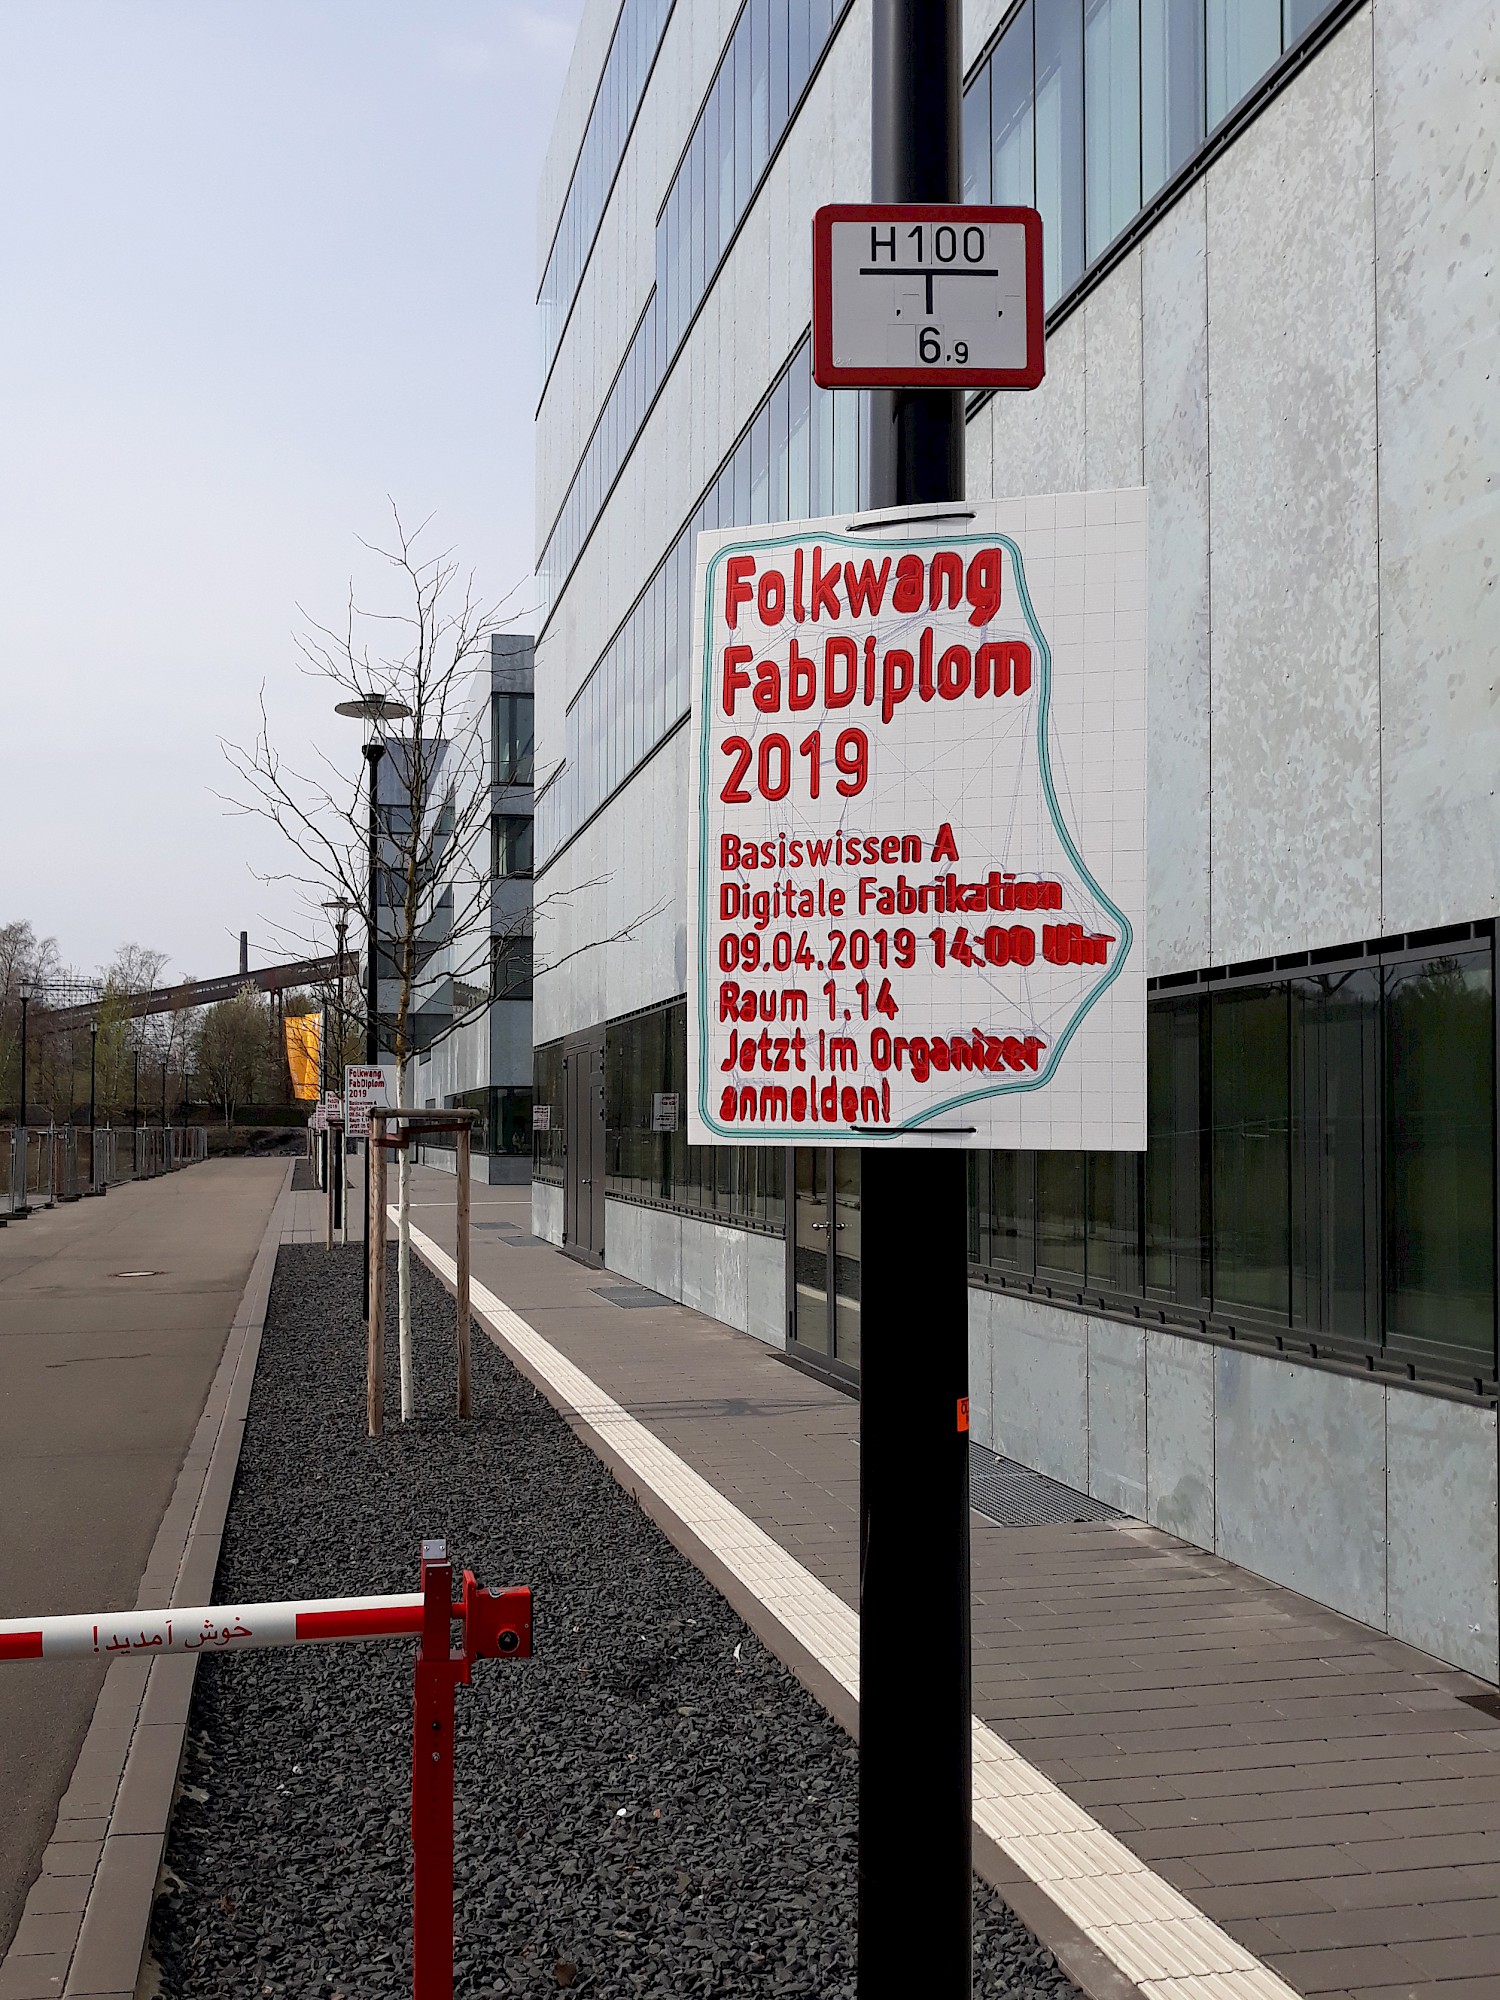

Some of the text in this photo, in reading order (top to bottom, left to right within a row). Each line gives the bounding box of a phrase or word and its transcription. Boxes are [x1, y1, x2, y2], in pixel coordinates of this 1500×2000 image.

[919, 326, 969, 364] 6,9
[725, 545, 1002, 630] Folkwang
[722, 626, 1032, 724] FabDiplom
[720, 727, 869, 804] 2019
[719, 823, 959, 872] Basiswissen A
[719, 871, 1063, 931] Digitale Fabrikation
[719, 922, 1116, 973] 09.04.2019 14:00 Uhr
[719, 977, 899, 1023] Raum 1.14
[349, 1069, 382, 1079] Folkwang
[719, 1026, 1047, 1083] Jetzt im Organizer
[349, 1079, 385, 1089] FabDiplom
[349, 1090, 367, 1098] 2019
[719, 1075, 892, 1123] anmelden!
[184, 1616, 253, 1649] خوش
